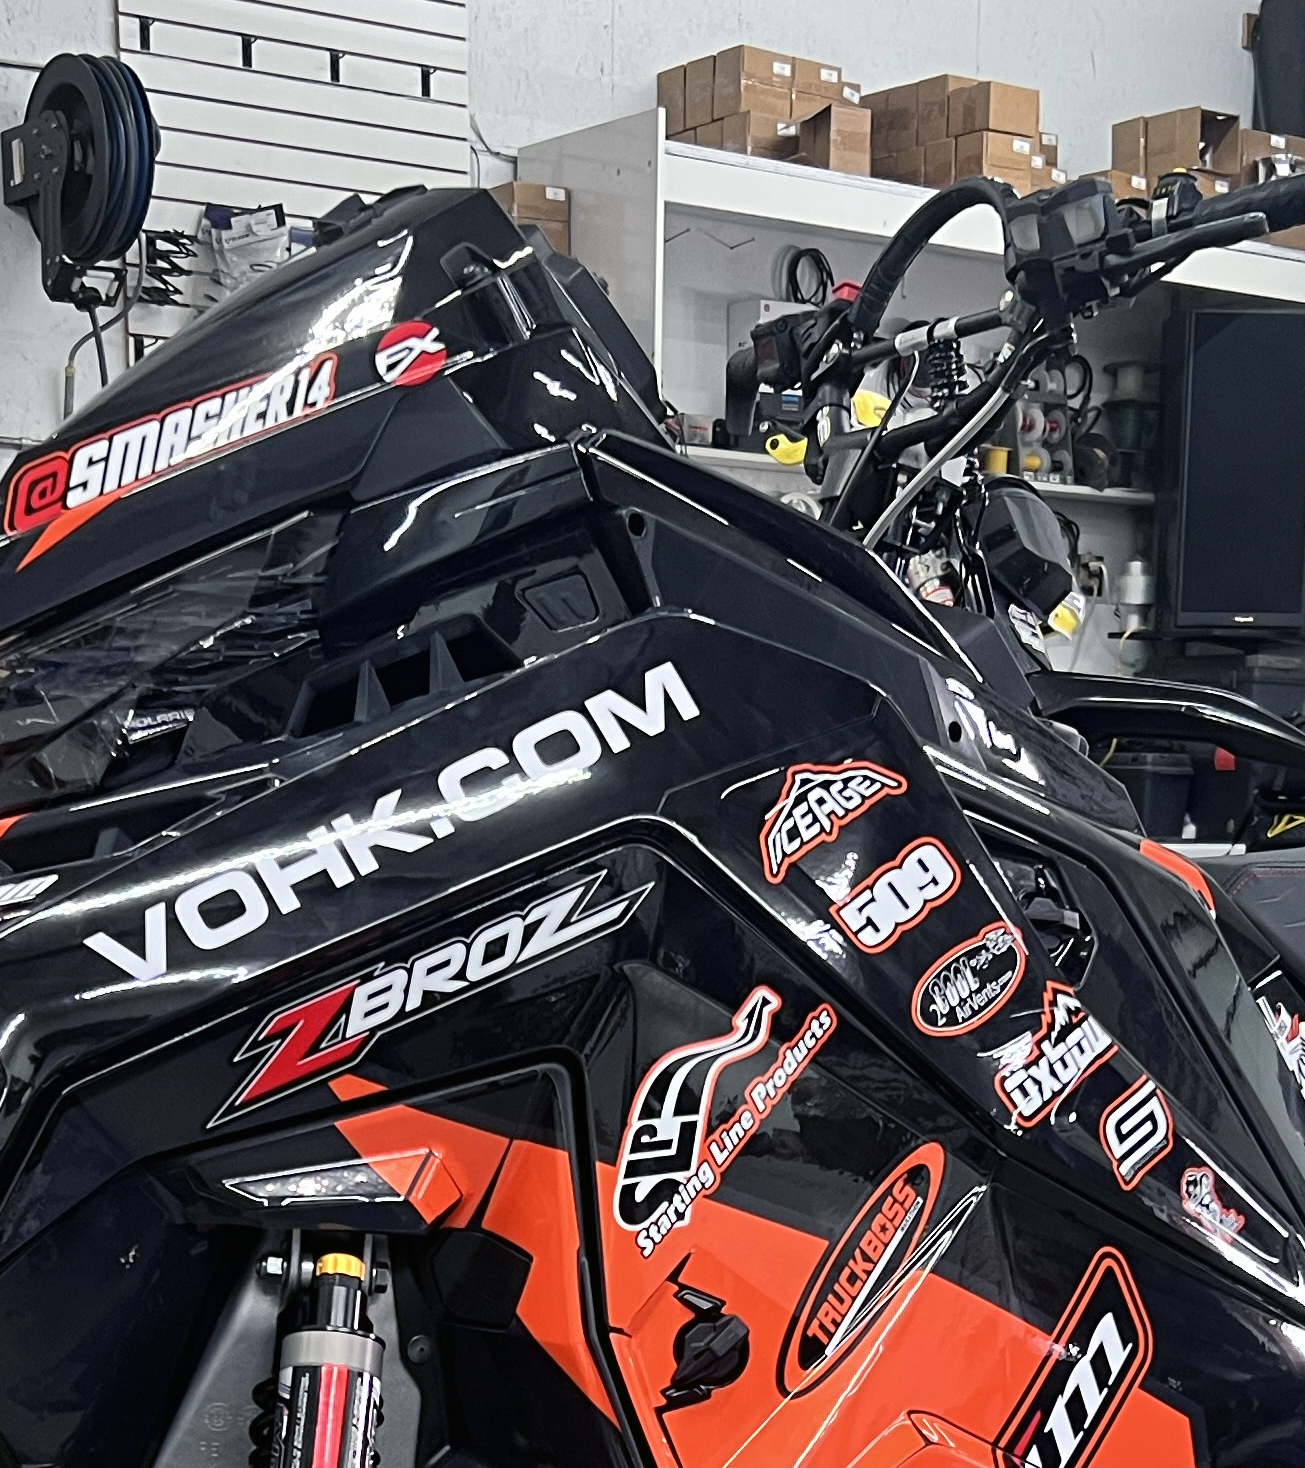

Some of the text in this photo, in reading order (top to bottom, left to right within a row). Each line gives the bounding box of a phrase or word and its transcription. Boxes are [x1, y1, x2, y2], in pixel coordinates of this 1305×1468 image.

[82, 661, 701, 983] VOHK.COM
[838, 844, 955, 947] 509
[222, 874, 644, 1115] ZBROZ
[636, 1009, 833, 1259] Starting Line Products
[806, 1173, 917, 1346] TRUCKBOSS
